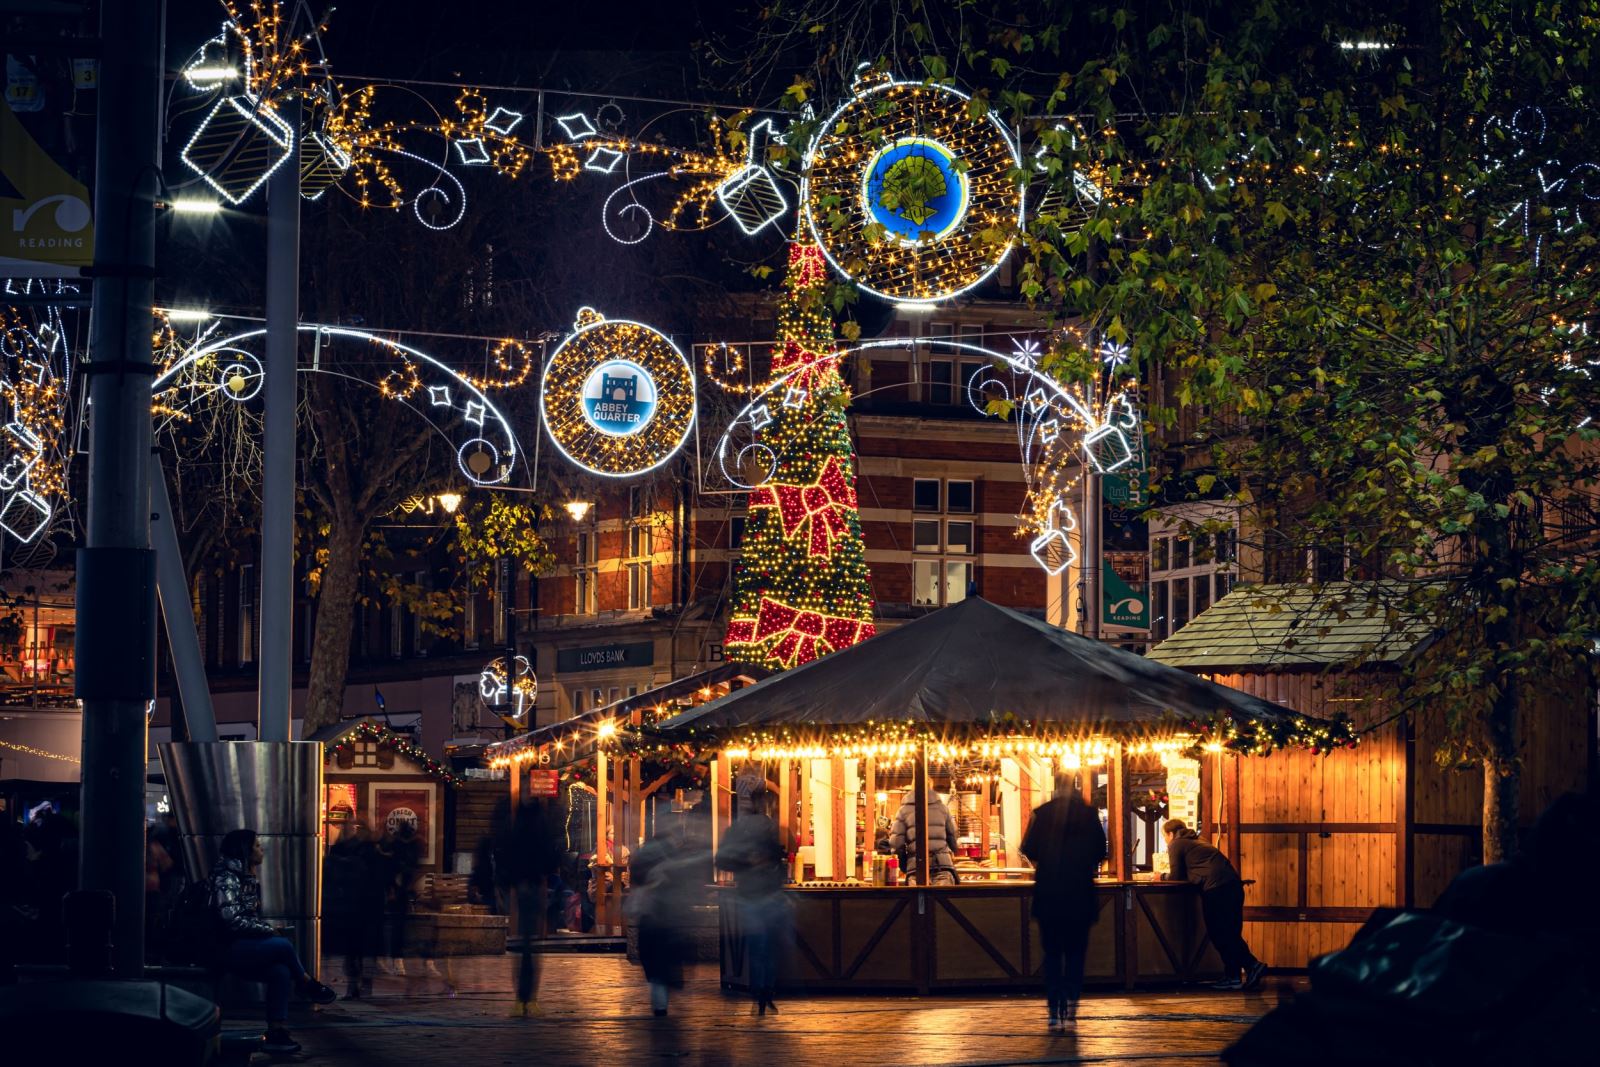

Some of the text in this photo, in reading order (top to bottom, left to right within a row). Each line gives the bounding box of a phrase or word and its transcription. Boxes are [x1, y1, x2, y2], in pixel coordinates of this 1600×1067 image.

[19, 238, 83, 248] READING
[594, 402, 628, 413] ABBEY
[593, 411, 640, 423] QUARTER
[580, 649, 625, 665] LLOYDS BANK
